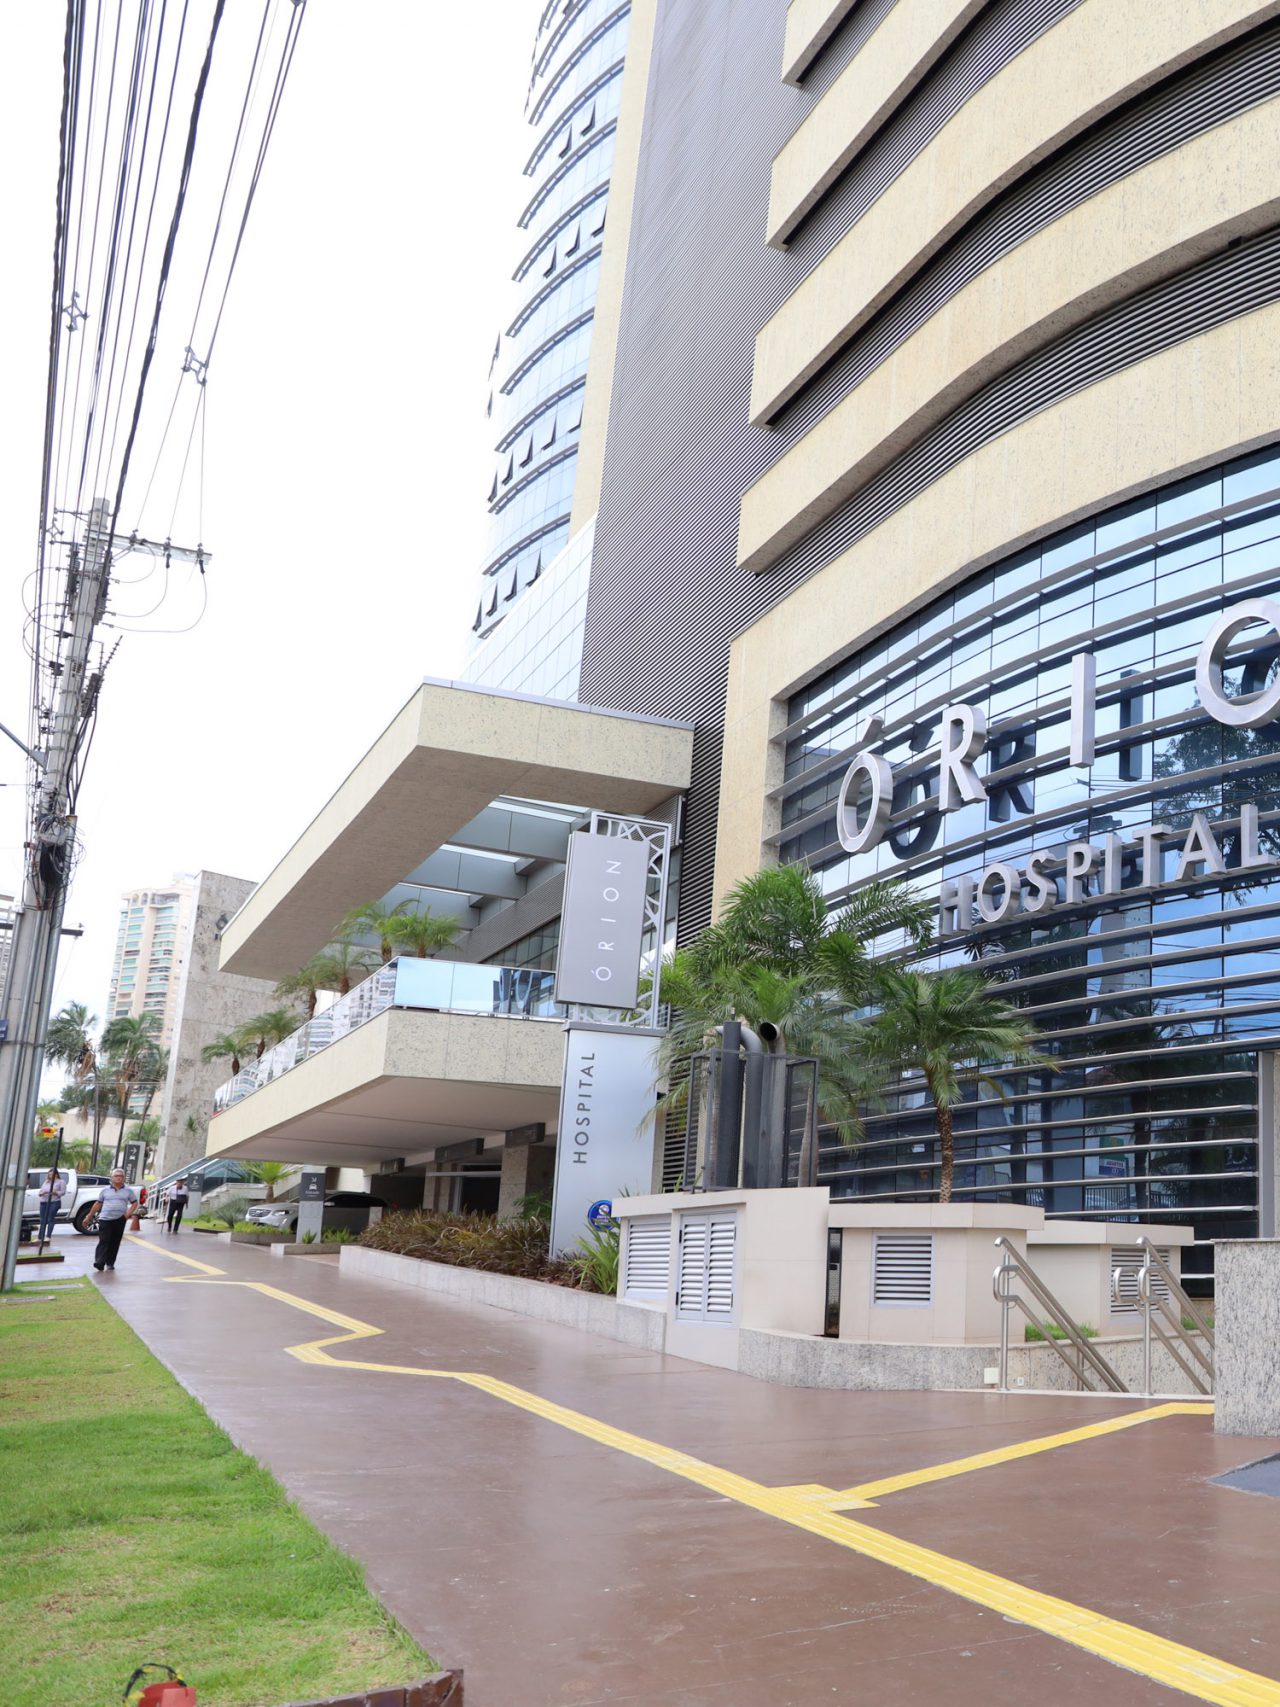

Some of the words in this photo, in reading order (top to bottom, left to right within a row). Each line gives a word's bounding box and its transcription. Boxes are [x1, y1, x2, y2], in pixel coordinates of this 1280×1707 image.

[591, 859, 622, 983] ÓRION
[939, 803, 1280, 937] HOSPITAL
[573, 1052, 595, 1165] HOSPITAL
